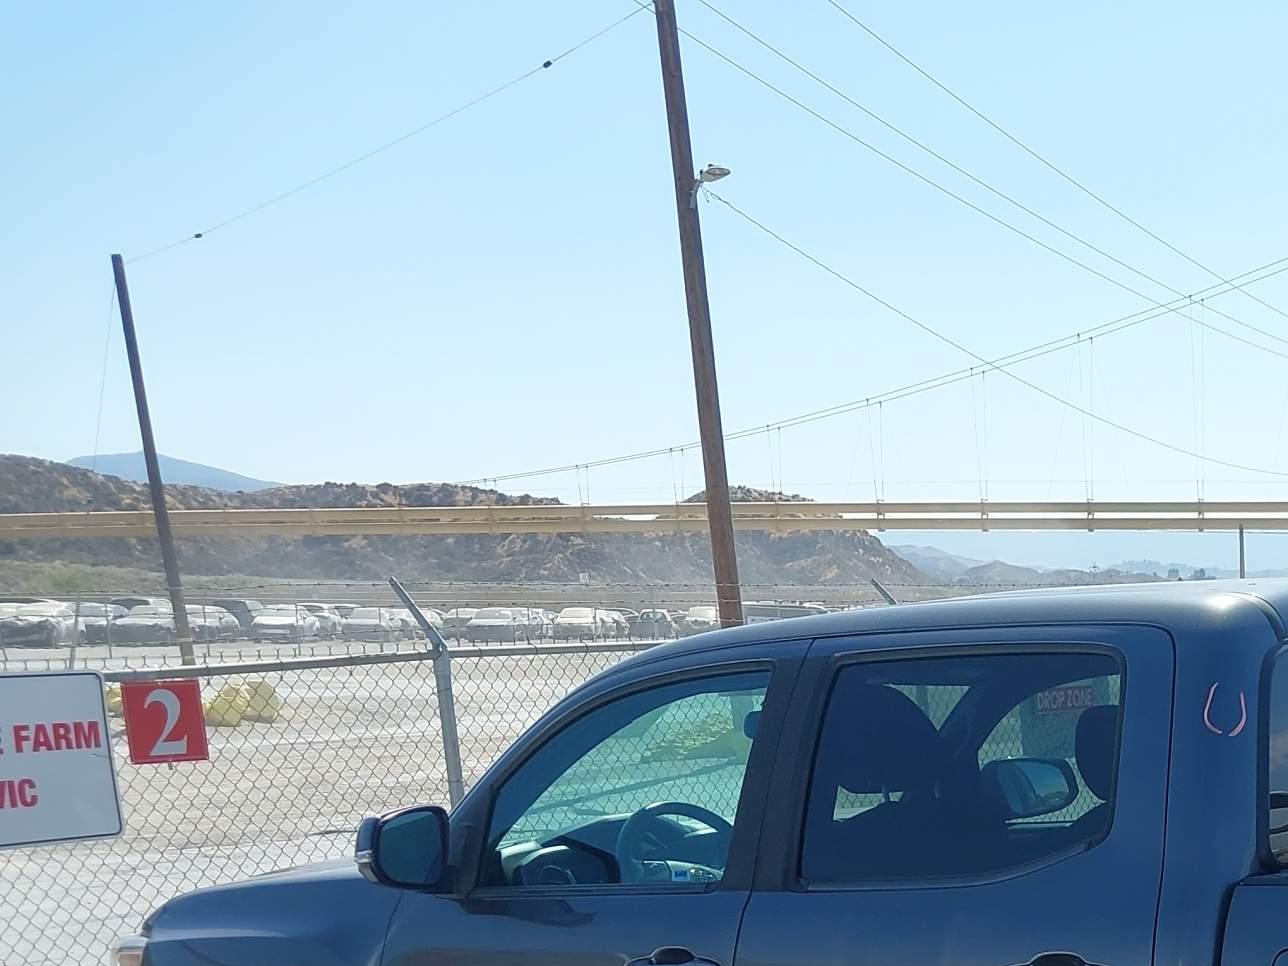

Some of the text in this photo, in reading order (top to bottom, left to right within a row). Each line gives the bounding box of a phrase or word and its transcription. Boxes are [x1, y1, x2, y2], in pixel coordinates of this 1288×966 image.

[1036, 687, 1094, 710] DROP ZONE
[13, 720, 102, 754] FARM
[143, 688, 188, 757] 2
